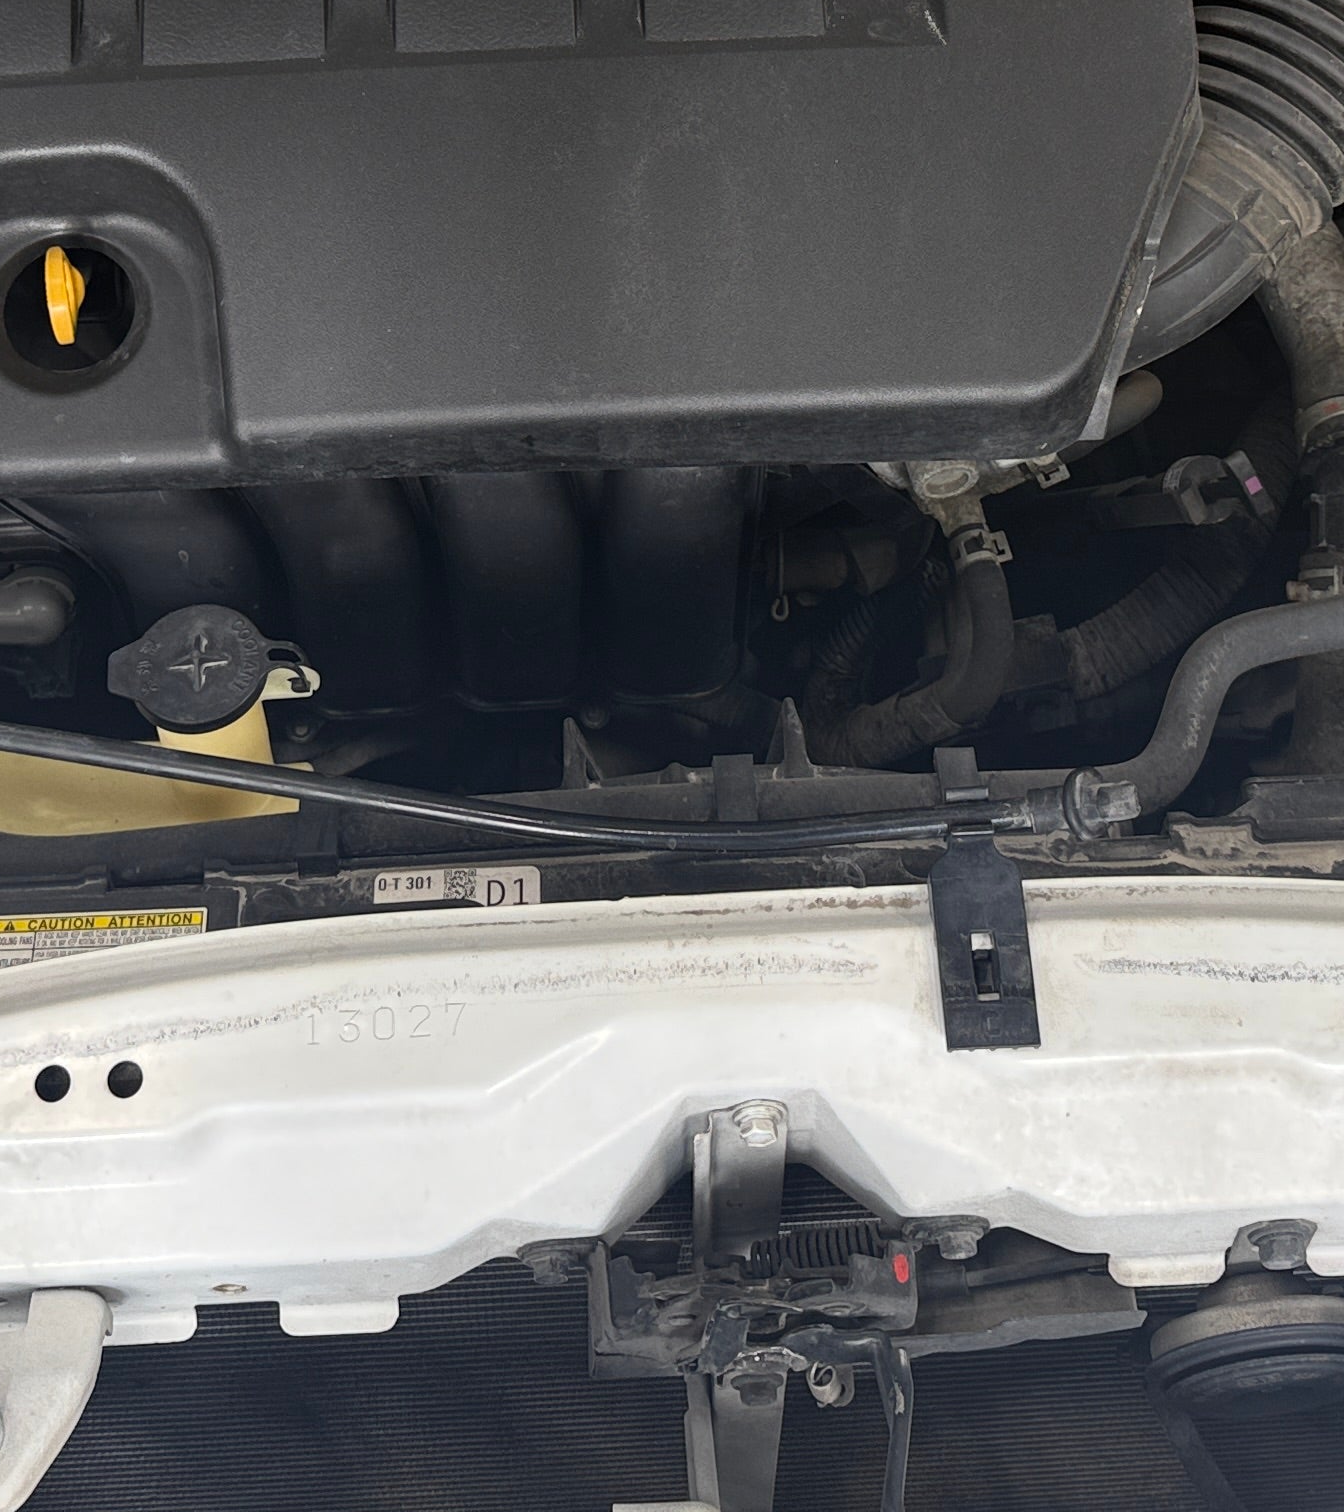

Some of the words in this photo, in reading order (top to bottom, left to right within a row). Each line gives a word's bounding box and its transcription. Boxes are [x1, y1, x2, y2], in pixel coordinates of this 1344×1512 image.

[27, 917, 96, 932] CAUTION
[107, 912, 194, 928] ATTENTION
[307, 1001, 468, 1046] 13027
